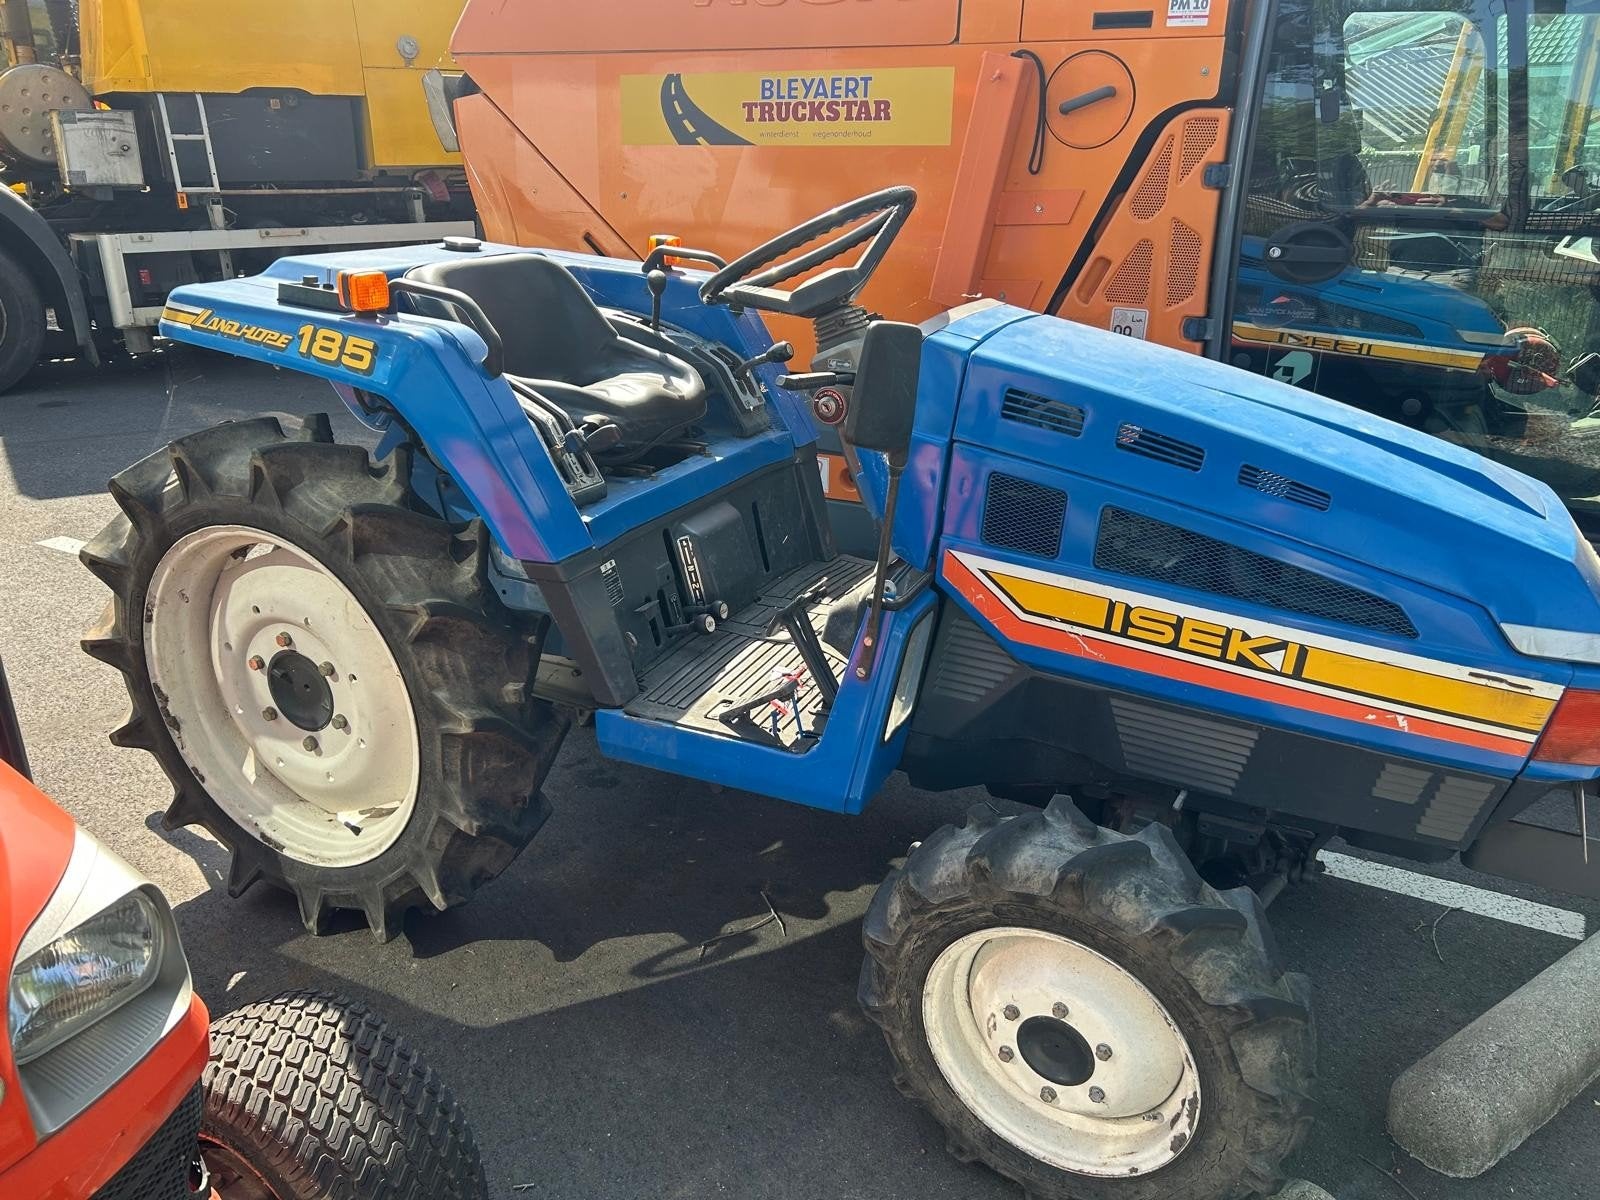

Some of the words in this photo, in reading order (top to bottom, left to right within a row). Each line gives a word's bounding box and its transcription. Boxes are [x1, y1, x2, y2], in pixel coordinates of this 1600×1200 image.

[1170, 0, 1190, 10] PM
[1193, 0, 1209, 10] 10
[760, 76, 872, 100] BLEYAERT
[742, 99, 892, 122] TRUCKSTAR
[759, 130, 799, 138] winterdienst
[812, 129, 872, 139] wegenonderhoud
[194, 309, 294, 350] LANDHOPE
[298, 323, 378, 374] 185
[1110, 600, 1300, 676] ISEKI
